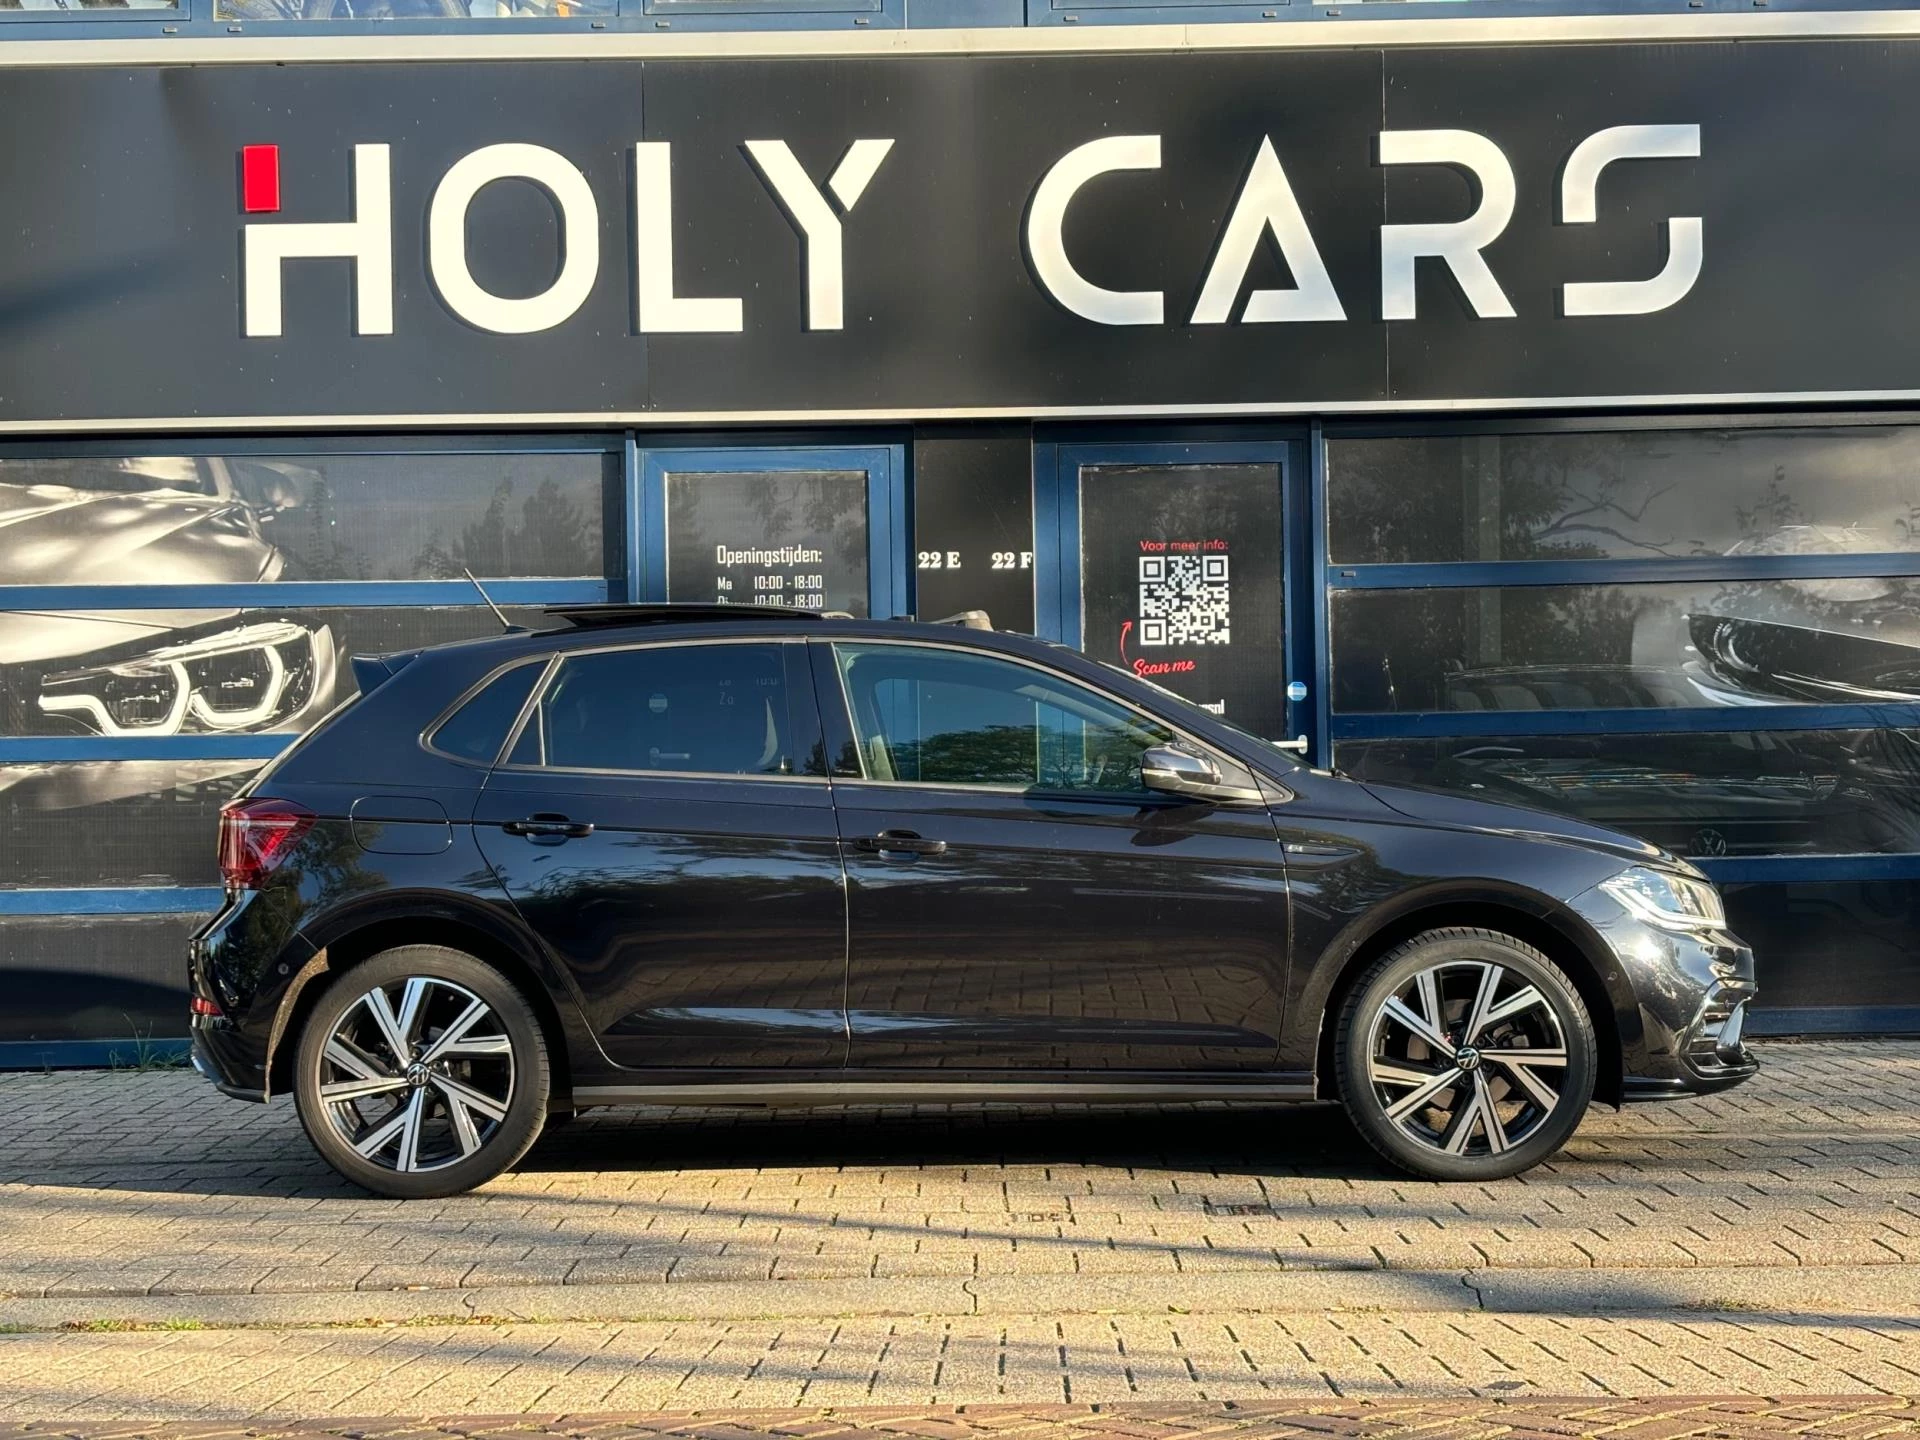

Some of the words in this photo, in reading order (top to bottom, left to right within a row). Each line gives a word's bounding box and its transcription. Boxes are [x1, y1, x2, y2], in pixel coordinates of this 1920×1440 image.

[242, 138, 895, 337] HOLY
[1027, 123, 1704, 325] CARS
[1140, 540, 1167, 552] Voor
[1170, 540, 1200, 551] meer
[1203, 539, 1229, 551] info:
[716, 544, 822, 568] Openingstijden:
[918, 551, 942, 568] 22
[946, 551, 961, 568] E
[991, 551, 1015, 569] 22
[1019, 551, 1033, 569] F
[717, 576, 733, 590] Ma
[754, 575, 783, 590] 10:00
[794, 574, 823, 589] 18:00
[793, 593, 823, 609] 18:00
[1132, 658, 1172, 677] Scan
[1172, 660, 1196, 672] me
